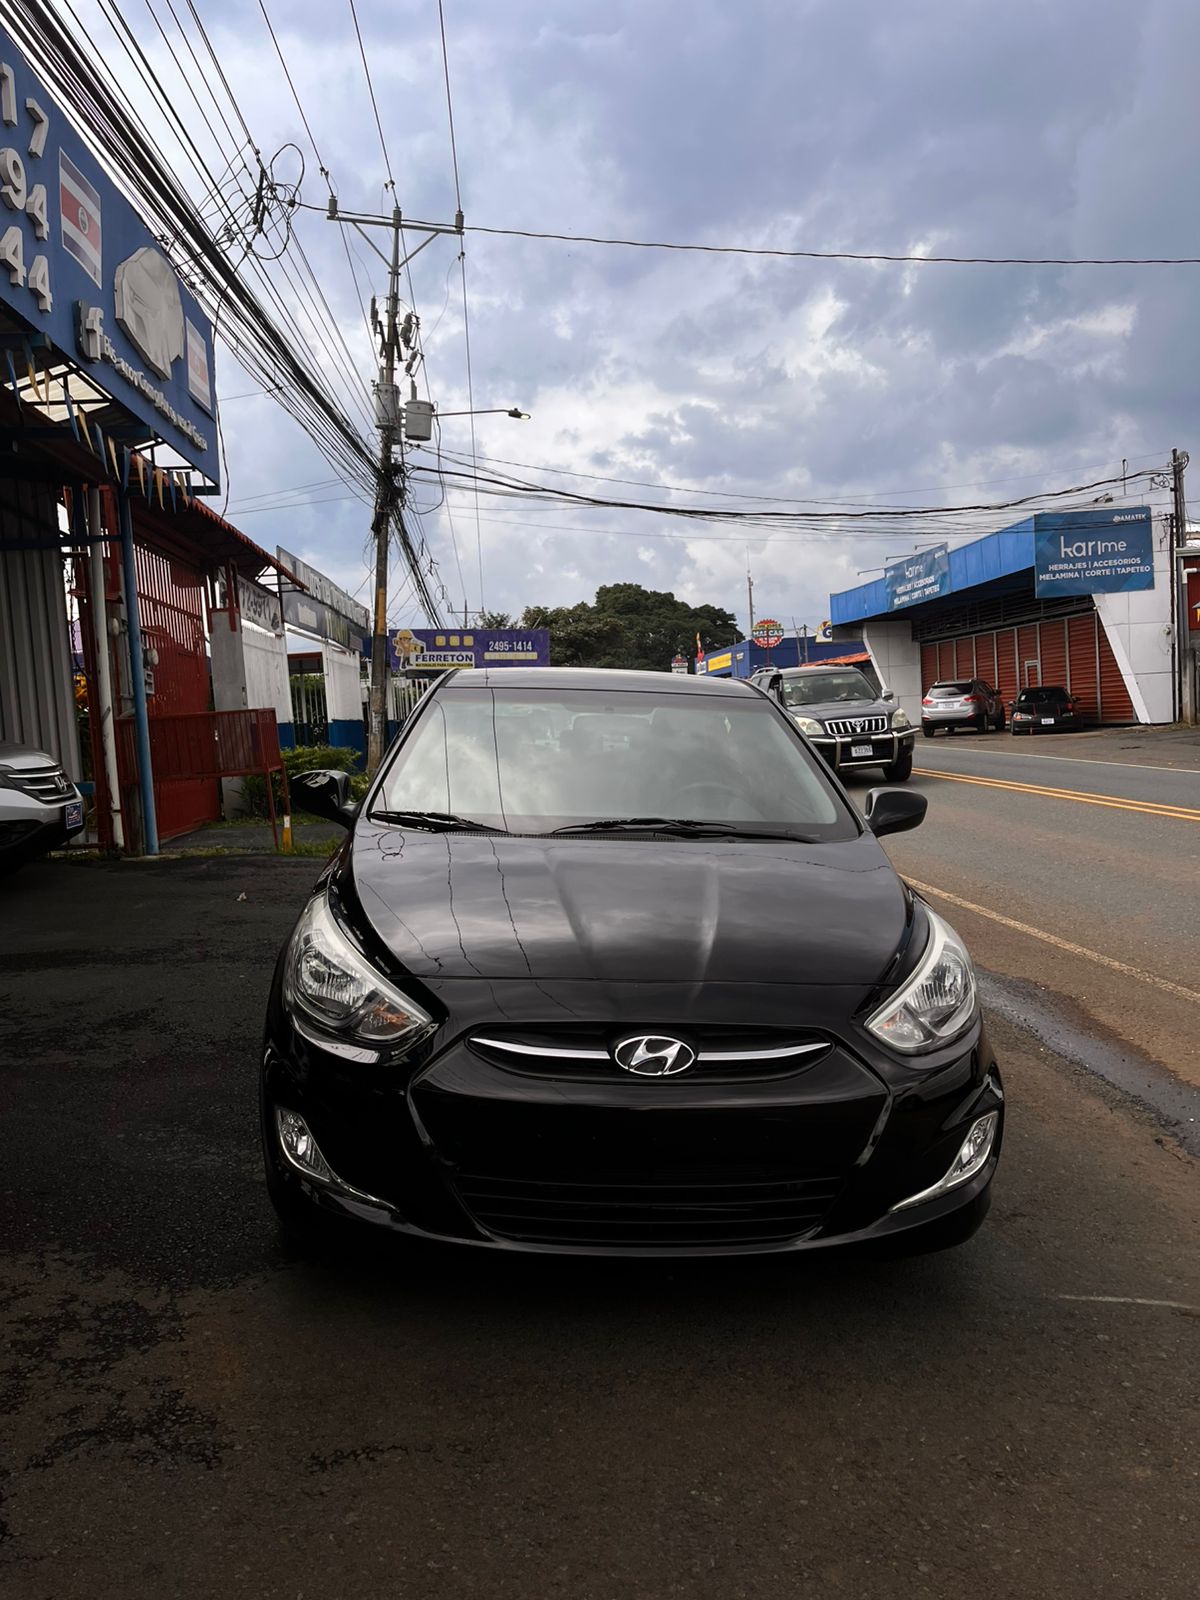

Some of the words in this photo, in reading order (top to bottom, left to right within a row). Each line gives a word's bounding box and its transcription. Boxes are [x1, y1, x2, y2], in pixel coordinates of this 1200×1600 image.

[1060, 535, 1127, 558] karime
[1048, 562, 1087, 571] HERRAJES
[1093, 557, 1141, 568] ACCESORIOS
[1039, 571, 1079, 581] MELAMINA
[1085, 569, 1111, 577] CORTE
[1117, 565, 1151, 575] TAPETEO
[488, 640, 532, 651] 2495-1414
[415, 652, 473, 662] FERRETÓN
